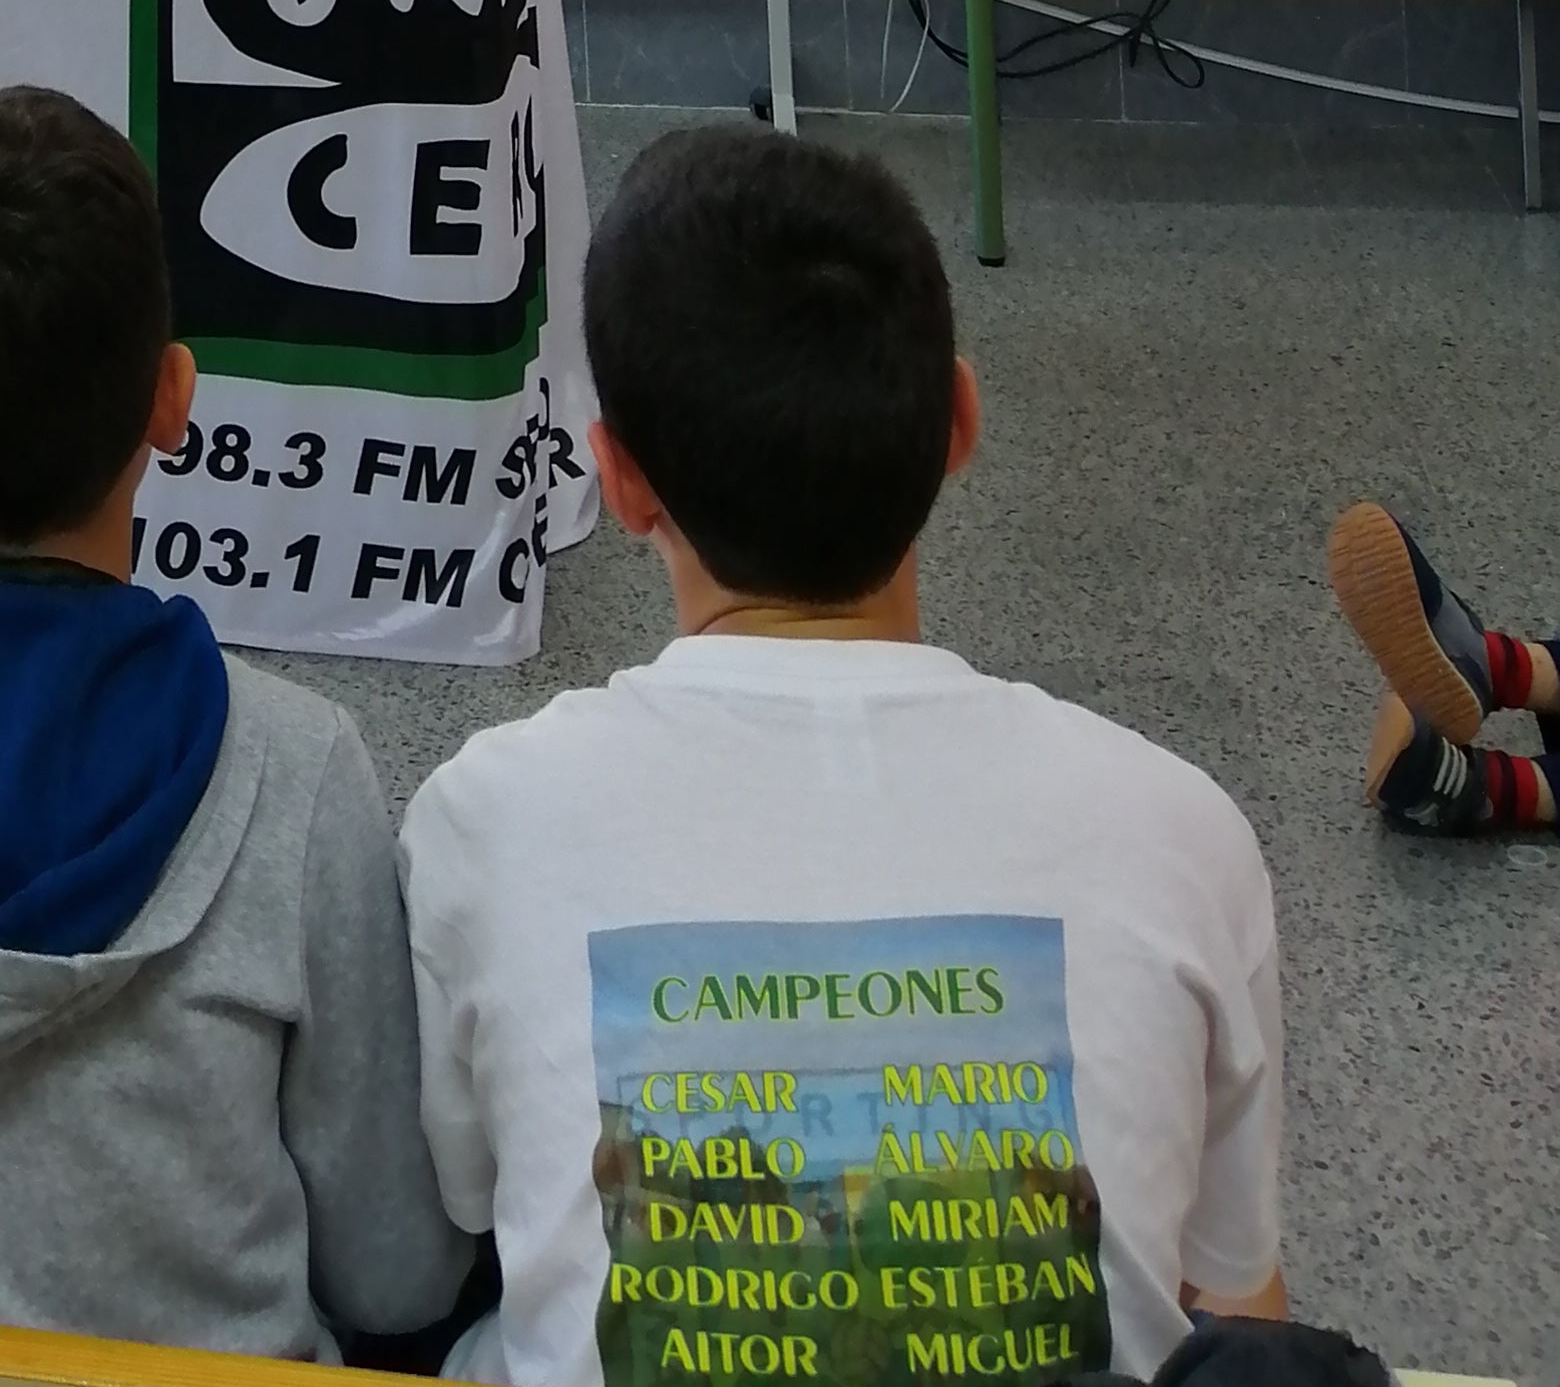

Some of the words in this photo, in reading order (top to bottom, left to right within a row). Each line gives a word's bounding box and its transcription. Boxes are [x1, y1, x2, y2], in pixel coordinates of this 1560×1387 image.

[156, 420, 326, 490] 98.3
[352, 437, 457, 506] FM
[350, 542, 455, 608] FM
[651, 967, 1005, 1022] CAMPEONES
[641, 1070, 798, 1114] CESAR
[882, 1060, 1049, 1106] MARIO
[642, 1136, 806, 1180] PABLO
[874, 1123, 1075, 1176] ÁLVARO
[648, 1201, 805, 1245] DAVID
[888, 1192, 1069, 1243] MIRIAM
[611, 1262, 860, 1312] RODRIGO
[661, 1327, 819, 1376] AITOR
[906, 1322, 1081, 1376] MIGUEL
